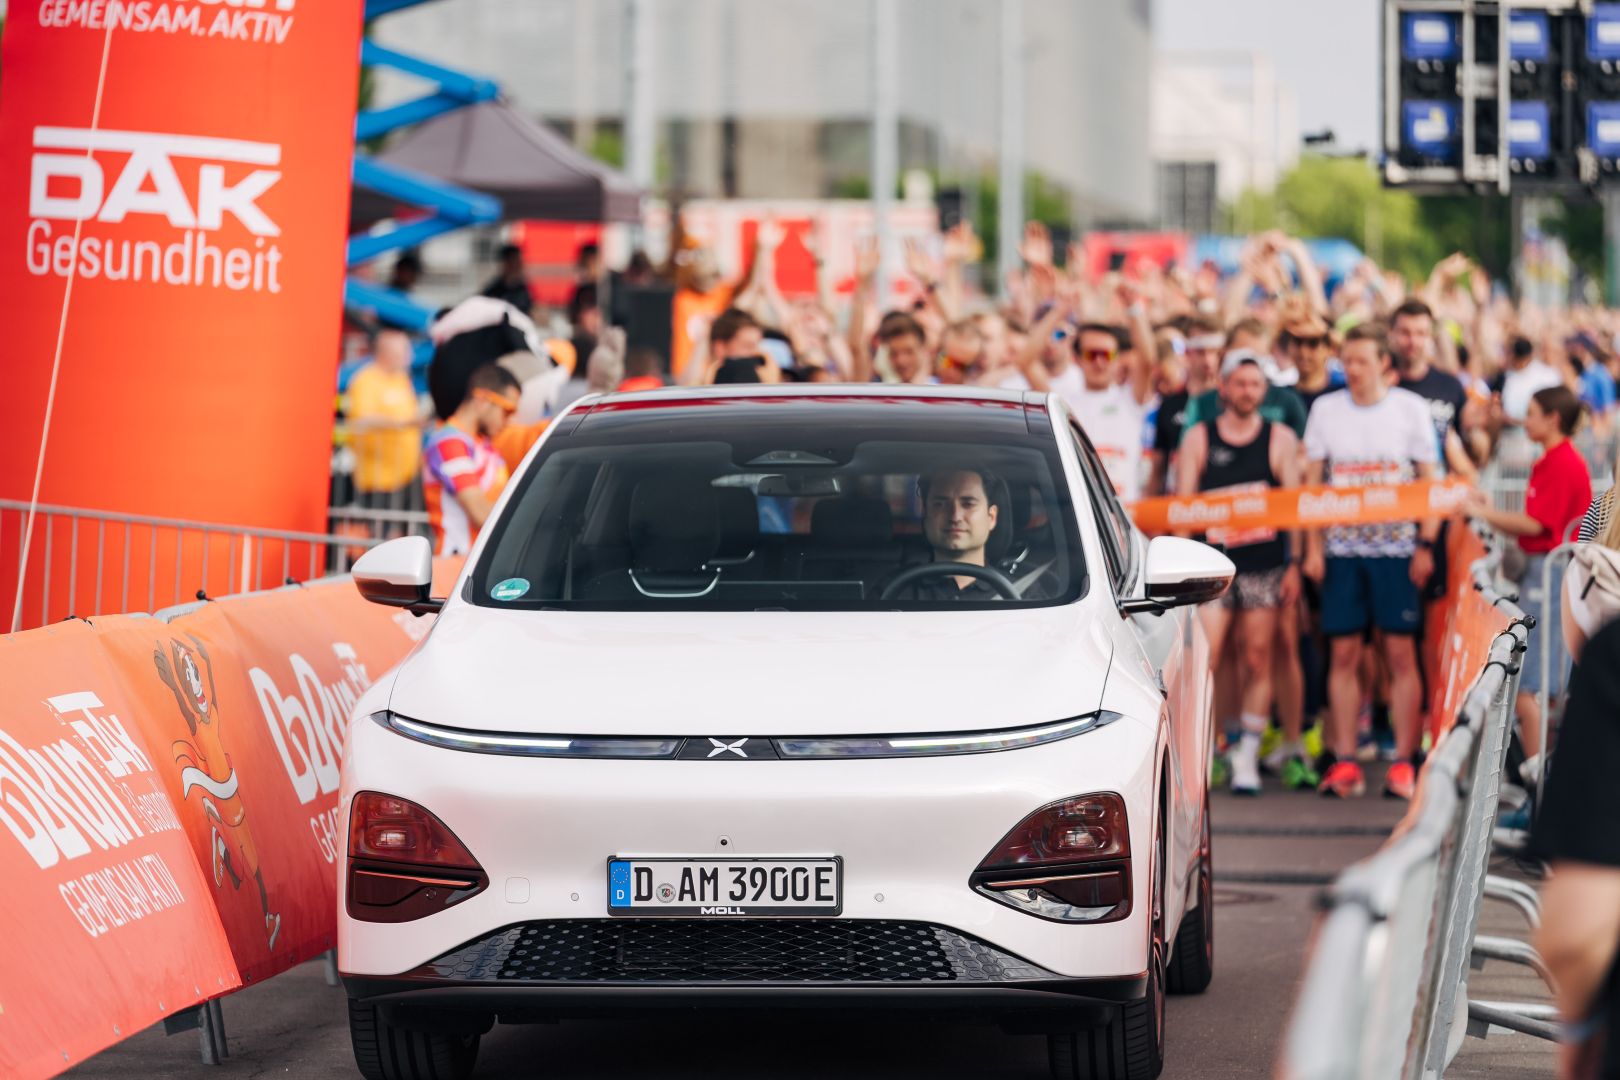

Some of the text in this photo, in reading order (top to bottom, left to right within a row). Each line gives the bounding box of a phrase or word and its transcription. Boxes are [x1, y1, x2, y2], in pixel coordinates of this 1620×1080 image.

[29, 125, 282, 237] DAK
[26, 219, 282, 293] Gesundheit
[47, 691, 153, 778] DAK
[617, 890, 625, 900] D
[634, 866, 653, 902] D
[678, 866, 719, 902] AM
[728, 866, 834, 902] 3900E
[700, 906, 745, 915] MOLL
